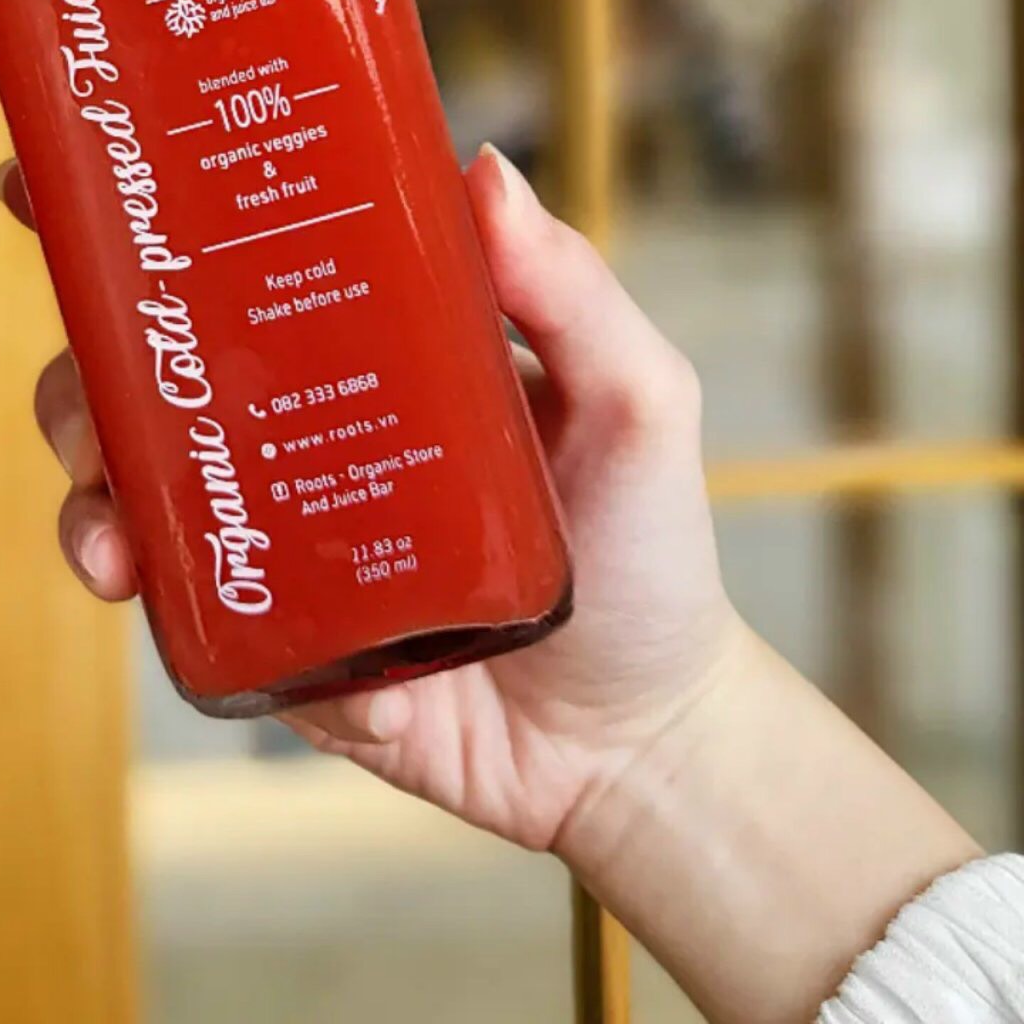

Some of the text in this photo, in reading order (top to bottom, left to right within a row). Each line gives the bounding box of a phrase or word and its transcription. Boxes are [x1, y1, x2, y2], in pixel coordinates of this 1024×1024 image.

[198, 57, 289, 93] blended with
[214, 83, 291, 133] 100%
[200, 124, 328, 173] organic veggies
[263, 160, 277, 178] &
[236, 176, 318, 211] fresh fruit
[265, 258, 336, 291] Keep cold
[248, 281, 370, 325] Shake before use
[271, 373, 379, 415] 082 333 6868
[283, 413, 399, 455] www.roots.vn
[295, 468, 336, 495] Roots
[348, 454, 403, 482] Organic
[404, 443, 443, 465] Store
[189, 415, 272, 615] Organic
[301, 480, 394, 516] And Juice Bar
[351, 535, 413, 564] 11.83 oz
[356, 554, 417, 584] (350 ml)
